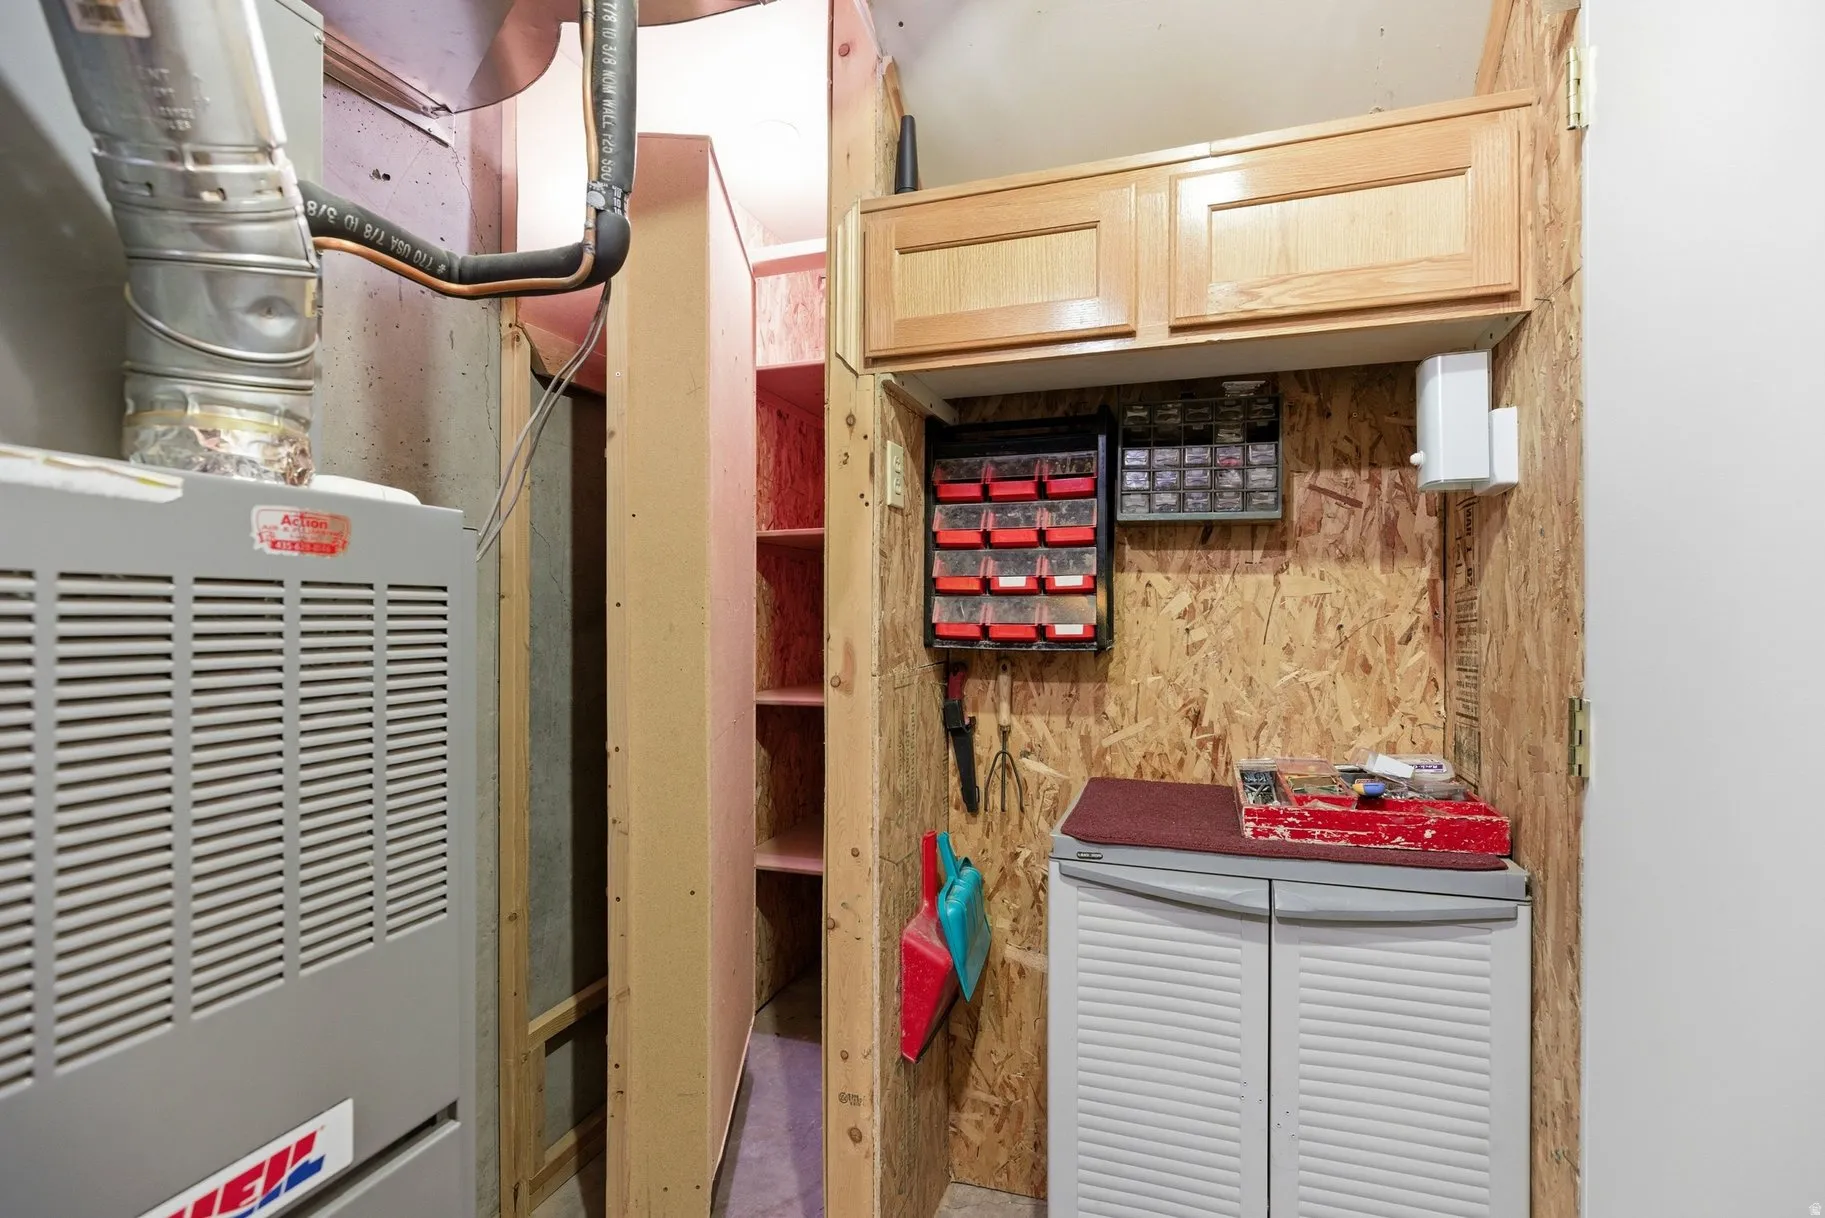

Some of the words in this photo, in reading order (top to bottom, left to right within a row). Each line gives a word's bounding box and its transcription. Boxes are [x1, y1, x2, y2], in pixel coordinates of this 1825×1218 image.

[602, 43, 617, 65] 3/8
[602, 69, 616, 95] NOM
[602, 99, 617, 129] WALL
[306, 200, 338, 224] 3/8
[363, 223, 385, 246] 7/8
[390, 235, 412, 259] USA
[280, 513, 329, 529] Action
